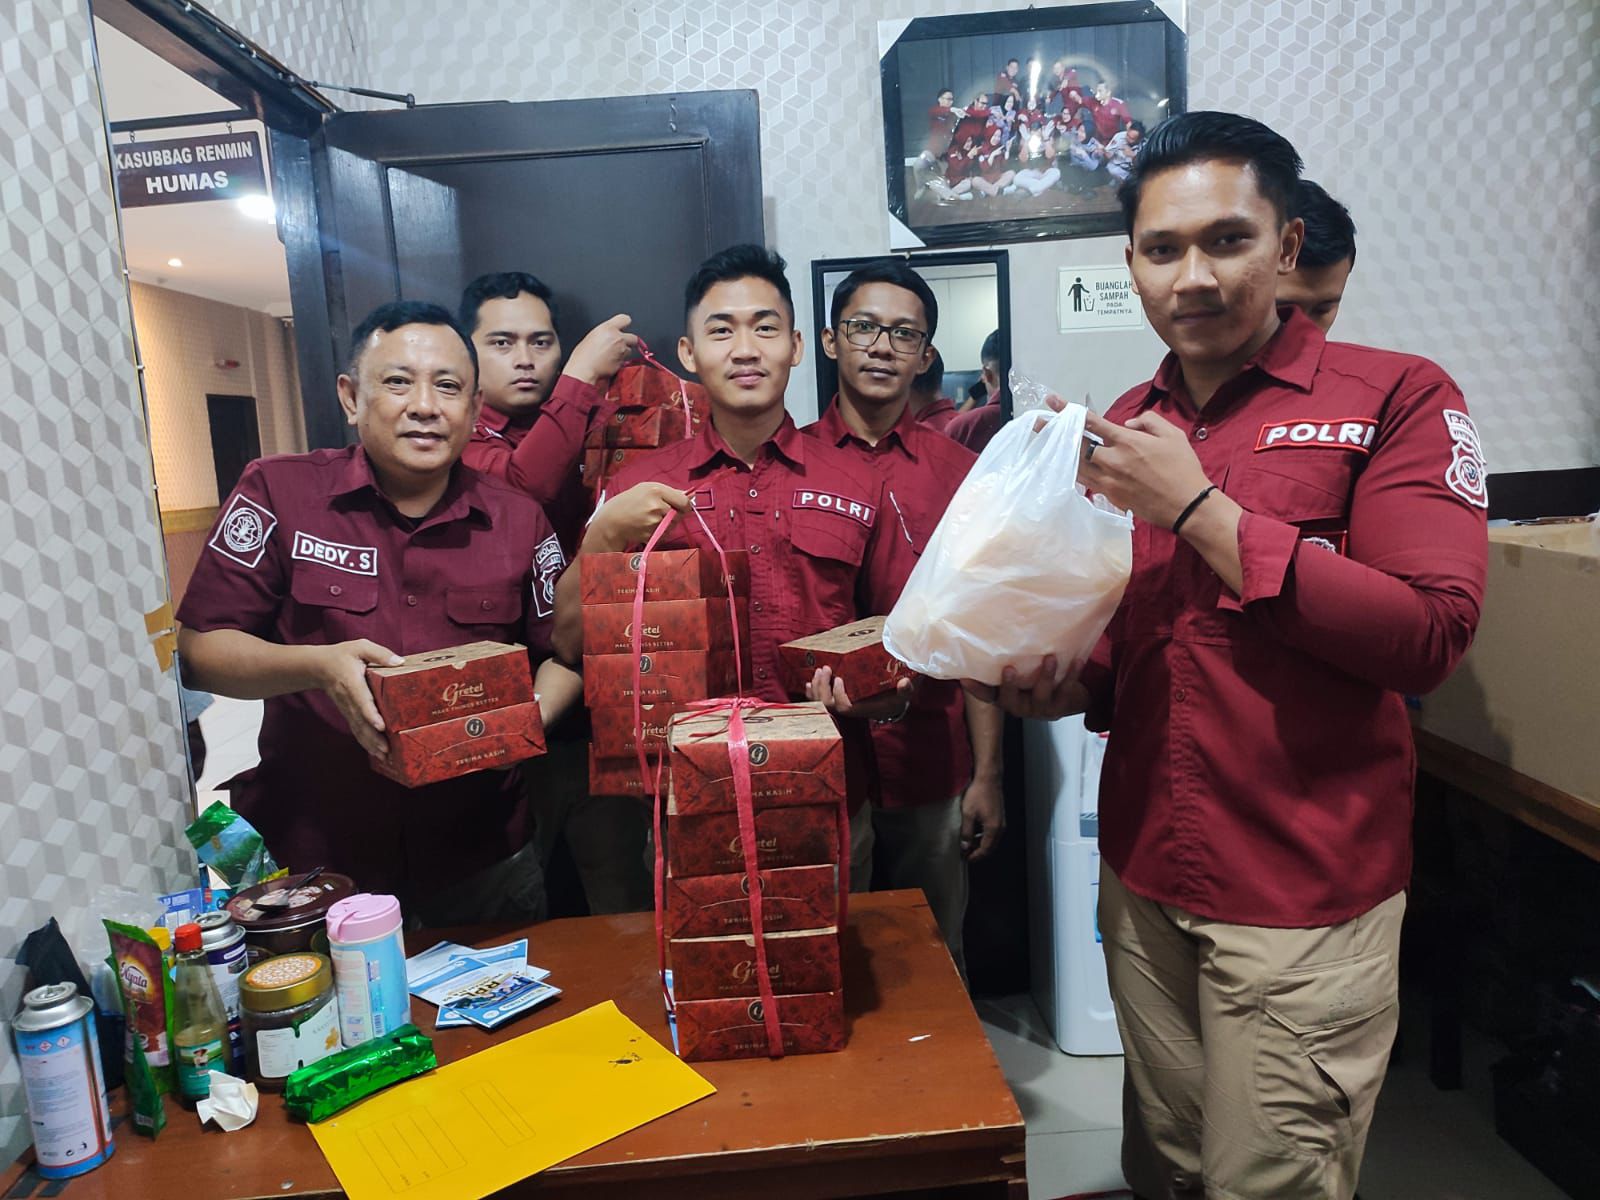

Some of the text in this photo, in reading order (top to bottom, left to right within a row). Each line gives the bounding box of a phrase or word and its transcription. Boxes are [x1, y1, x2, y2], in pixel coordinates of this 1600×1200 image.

[115, 141, 253, 170] KASUBBAG RENMIN
[146, 171, 229, 194] HUMAS
[1099, 291, 1129, 301] SAMPAH
[1265, 422, 1376, 447] POLRI
[801, 492, 871, 521] POLRI
[359, 552, 371, 570] S
[442, 682, 485, 707] Gretel
